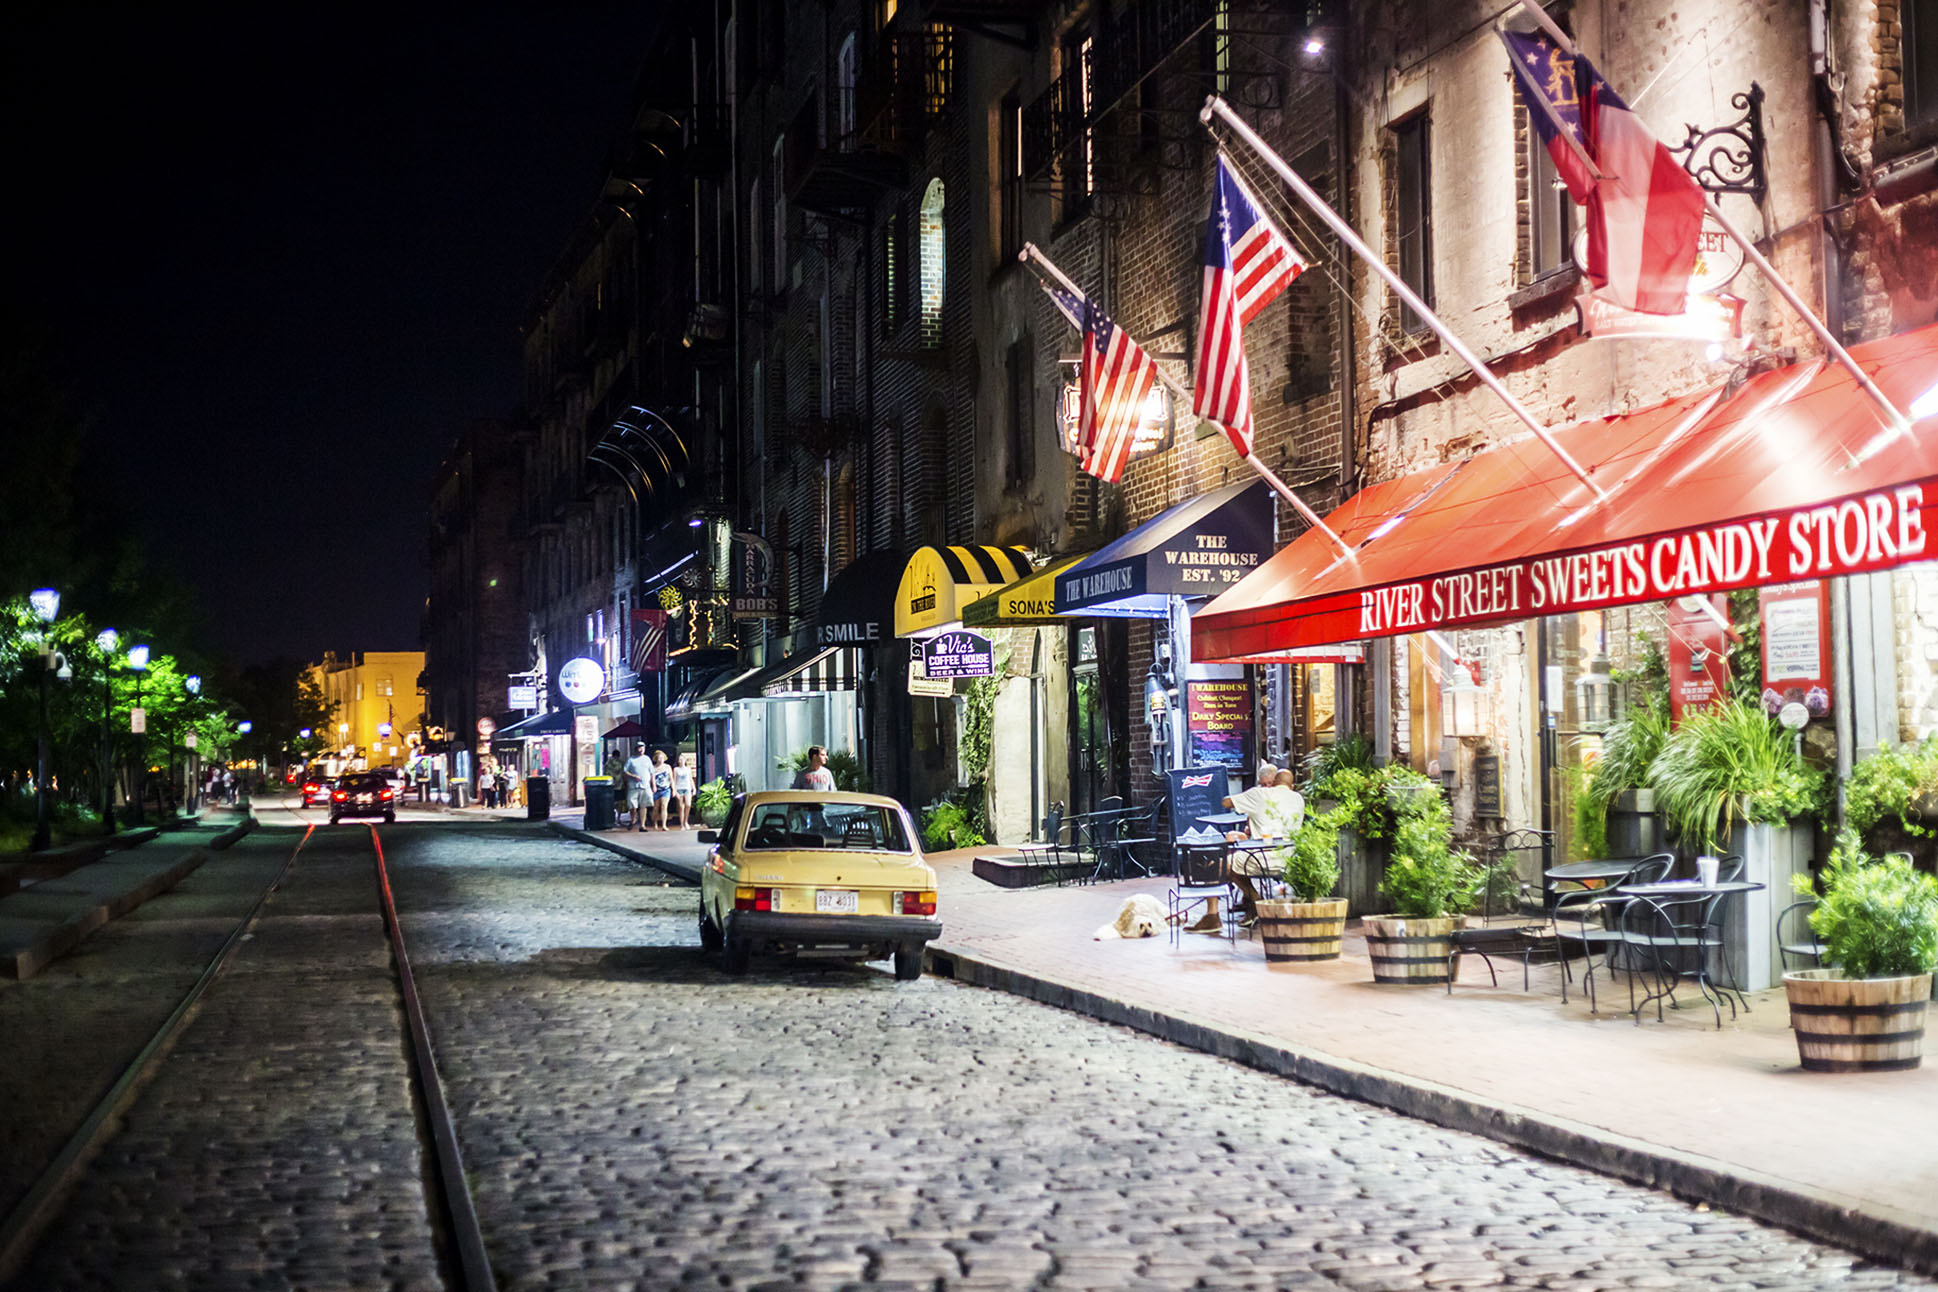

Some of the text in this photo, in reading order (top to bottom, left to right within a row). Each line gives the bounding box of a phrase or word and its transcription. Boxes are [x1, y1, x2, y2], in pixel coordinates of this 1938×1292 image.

[1697, 232, 1728, 252] EET
[1196, 535, 1227, 548] THE
[1165, 551, 1258, 566] WAREHOUSE
[1359, 484, 1926, 633] RIVER STREET SWEETS CANDY STORE
[1182, 569, 1241, 583] EST. '92
[1066, 566, 1133, 602] THE WAREHOUSE
[735, 598, 778, 611] BOB'S
[1009, 600, 1055, 614] SONA'S
[825, 622, 880, 642] SMILE
[943, 634, 975, 654] Vic's
[928, 653, 990, 666] COFFEE HOUSE
[966, 667, 990, 675] WINE
[1196, 683, 1248, 691] WAREHOUSE
[1192, 712, 1215, 720] DAILY
[1208, 721, 1234, 730] BOARD
